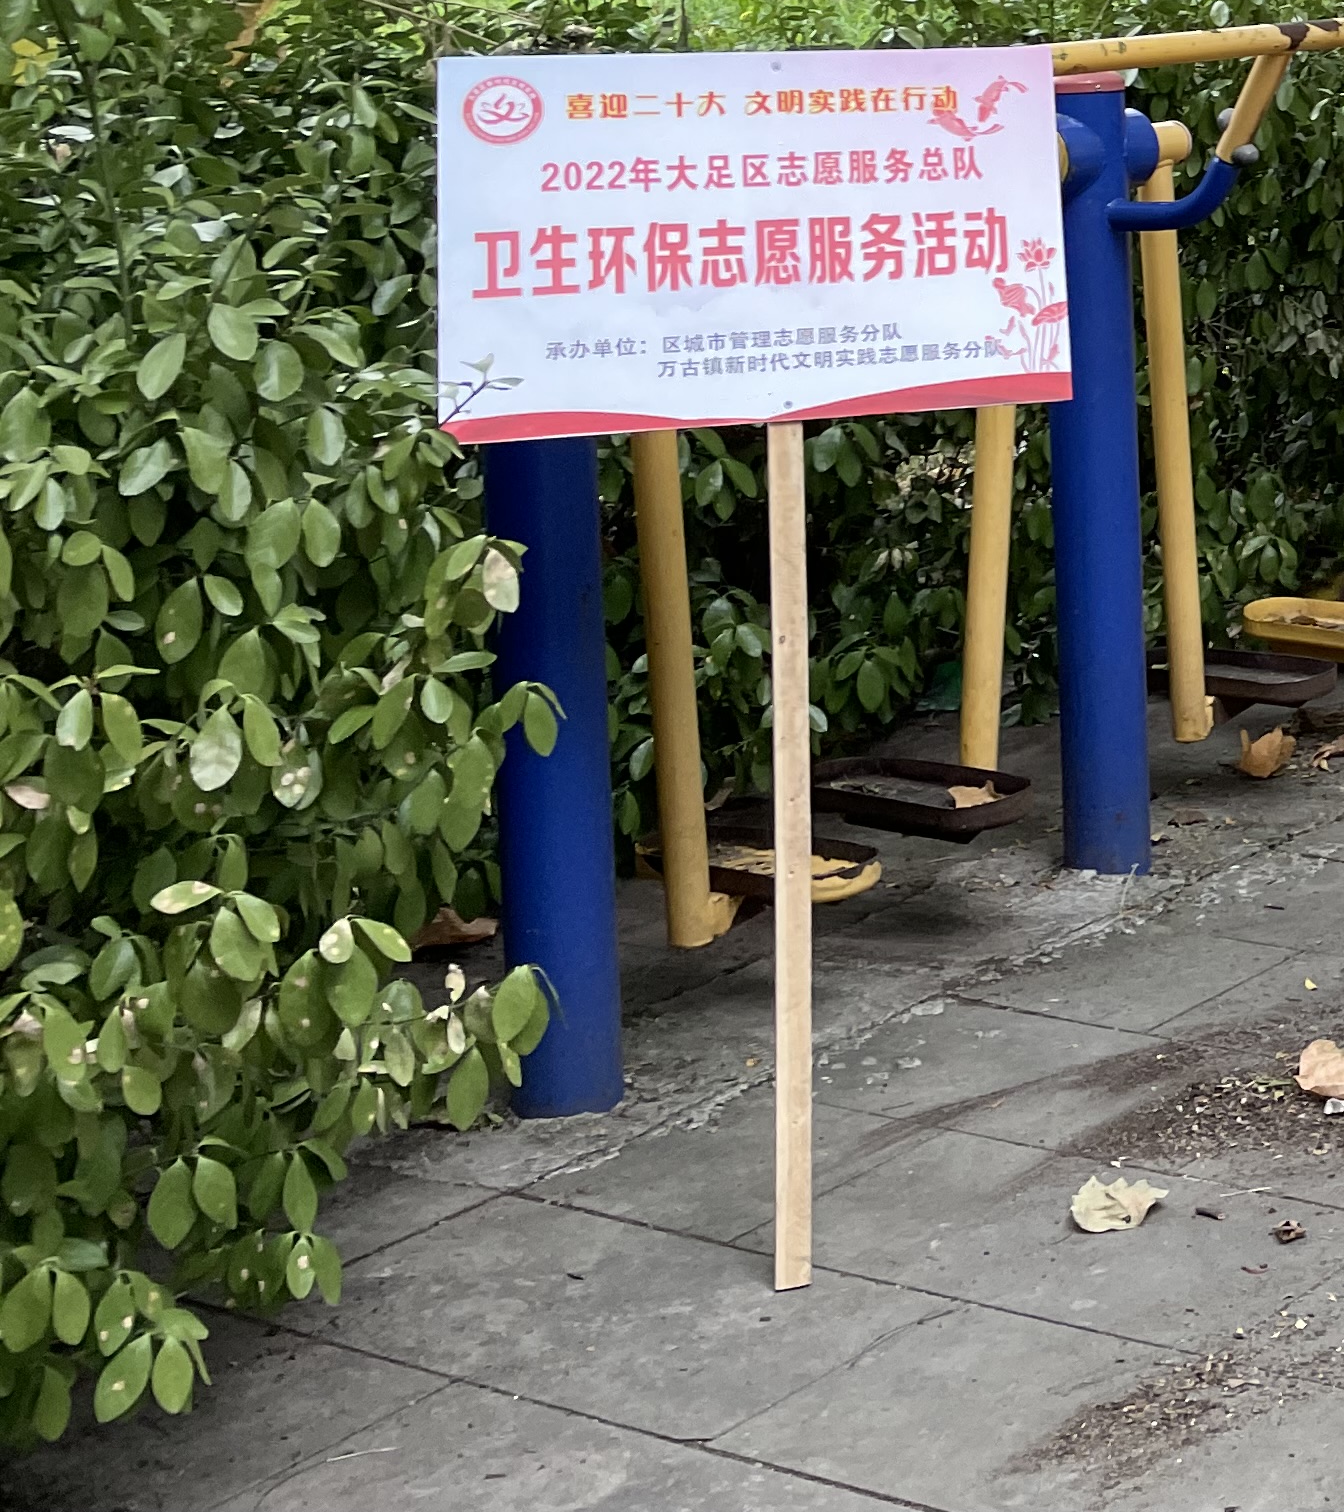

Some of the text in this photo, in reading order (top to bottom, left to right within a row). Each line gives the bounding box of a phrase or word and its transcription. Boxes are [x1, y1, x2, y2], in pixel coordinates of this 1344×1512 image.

[566, 85, 958, 120] 喜迎二十大 文明实践在行动
[541, 145, 983, 193] 2022年大足区志愿服务总队
[472, 207, 1008, 299] 卫生环保志愿服务活动
[656, 338, 1003, 378] 万古镇新时代文明实践志愿服务分队
